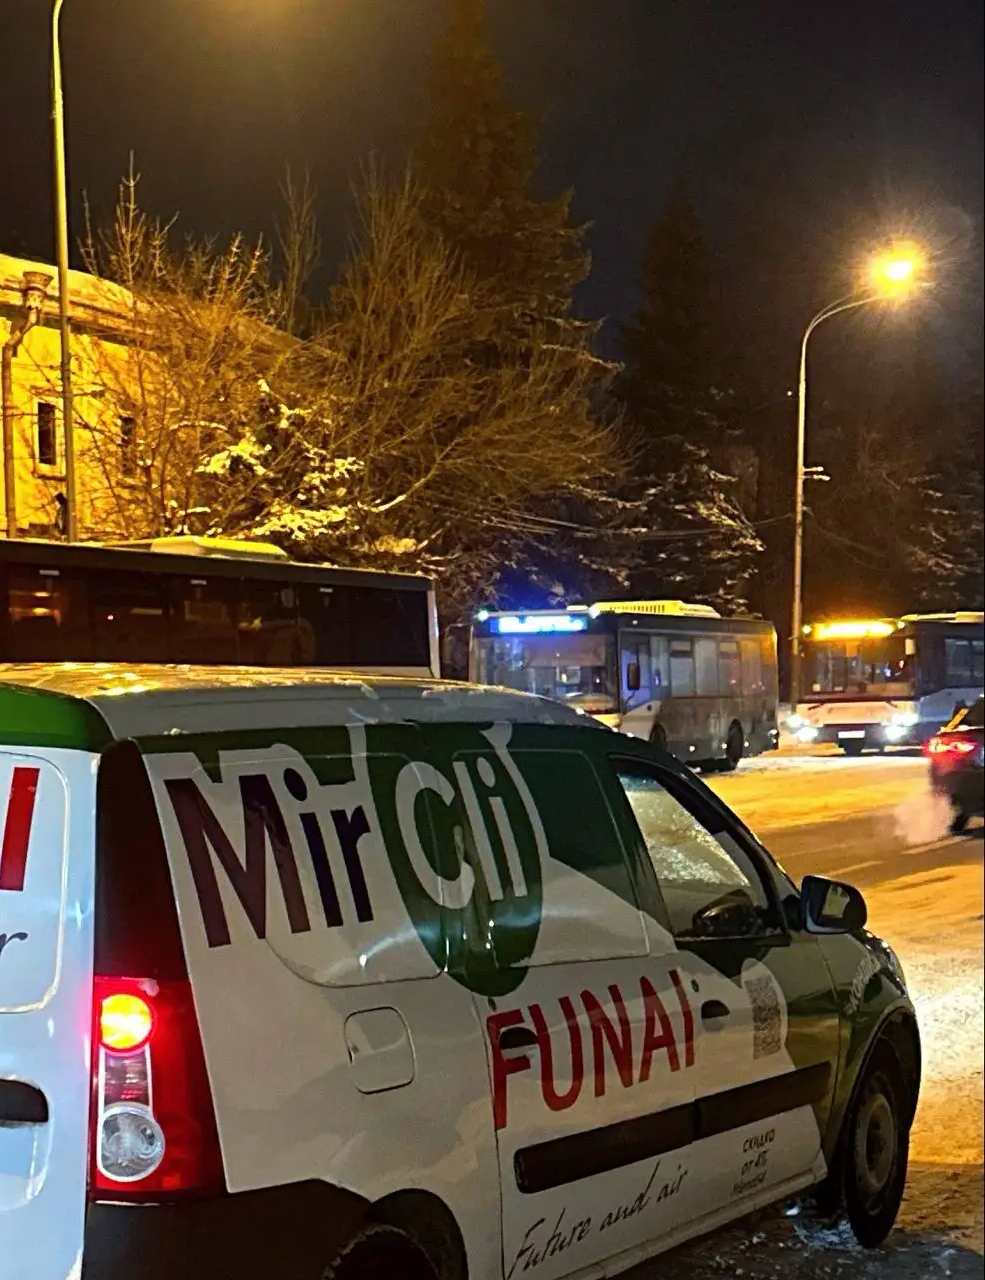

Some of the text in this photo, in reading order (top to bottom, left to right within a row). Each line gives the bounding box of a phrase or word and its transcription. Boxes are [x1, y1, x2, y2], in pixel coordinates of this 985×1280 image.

[485, 968, 695, 1132] FUNAI
[506, 1160, 689, 1280] Future and air
